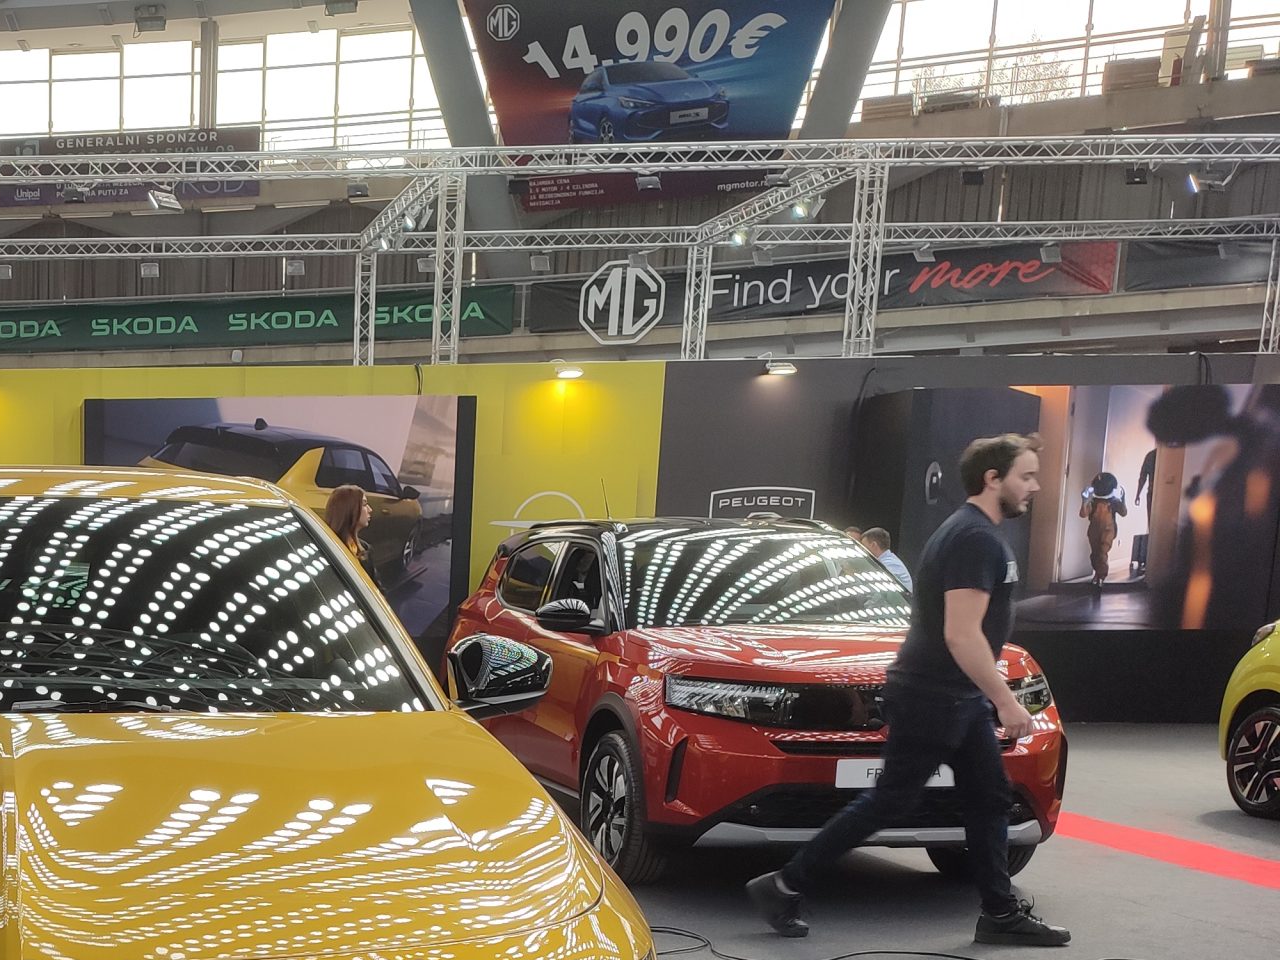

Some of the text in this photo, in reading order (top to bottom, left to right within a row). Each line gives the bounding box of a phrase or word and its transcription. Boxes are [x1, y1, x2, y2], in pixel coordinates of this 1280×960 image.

[489, 6, 518, 39] MG
[522, 7, 788, 79] 14.990€
[56, 131, 218, 148] GENERALNI SPONZOR
[585, 264, 660, 340] MG
[708, 258, 1057, 309] Find yor more
[719, 496, 806, 508] PEUGEOT
